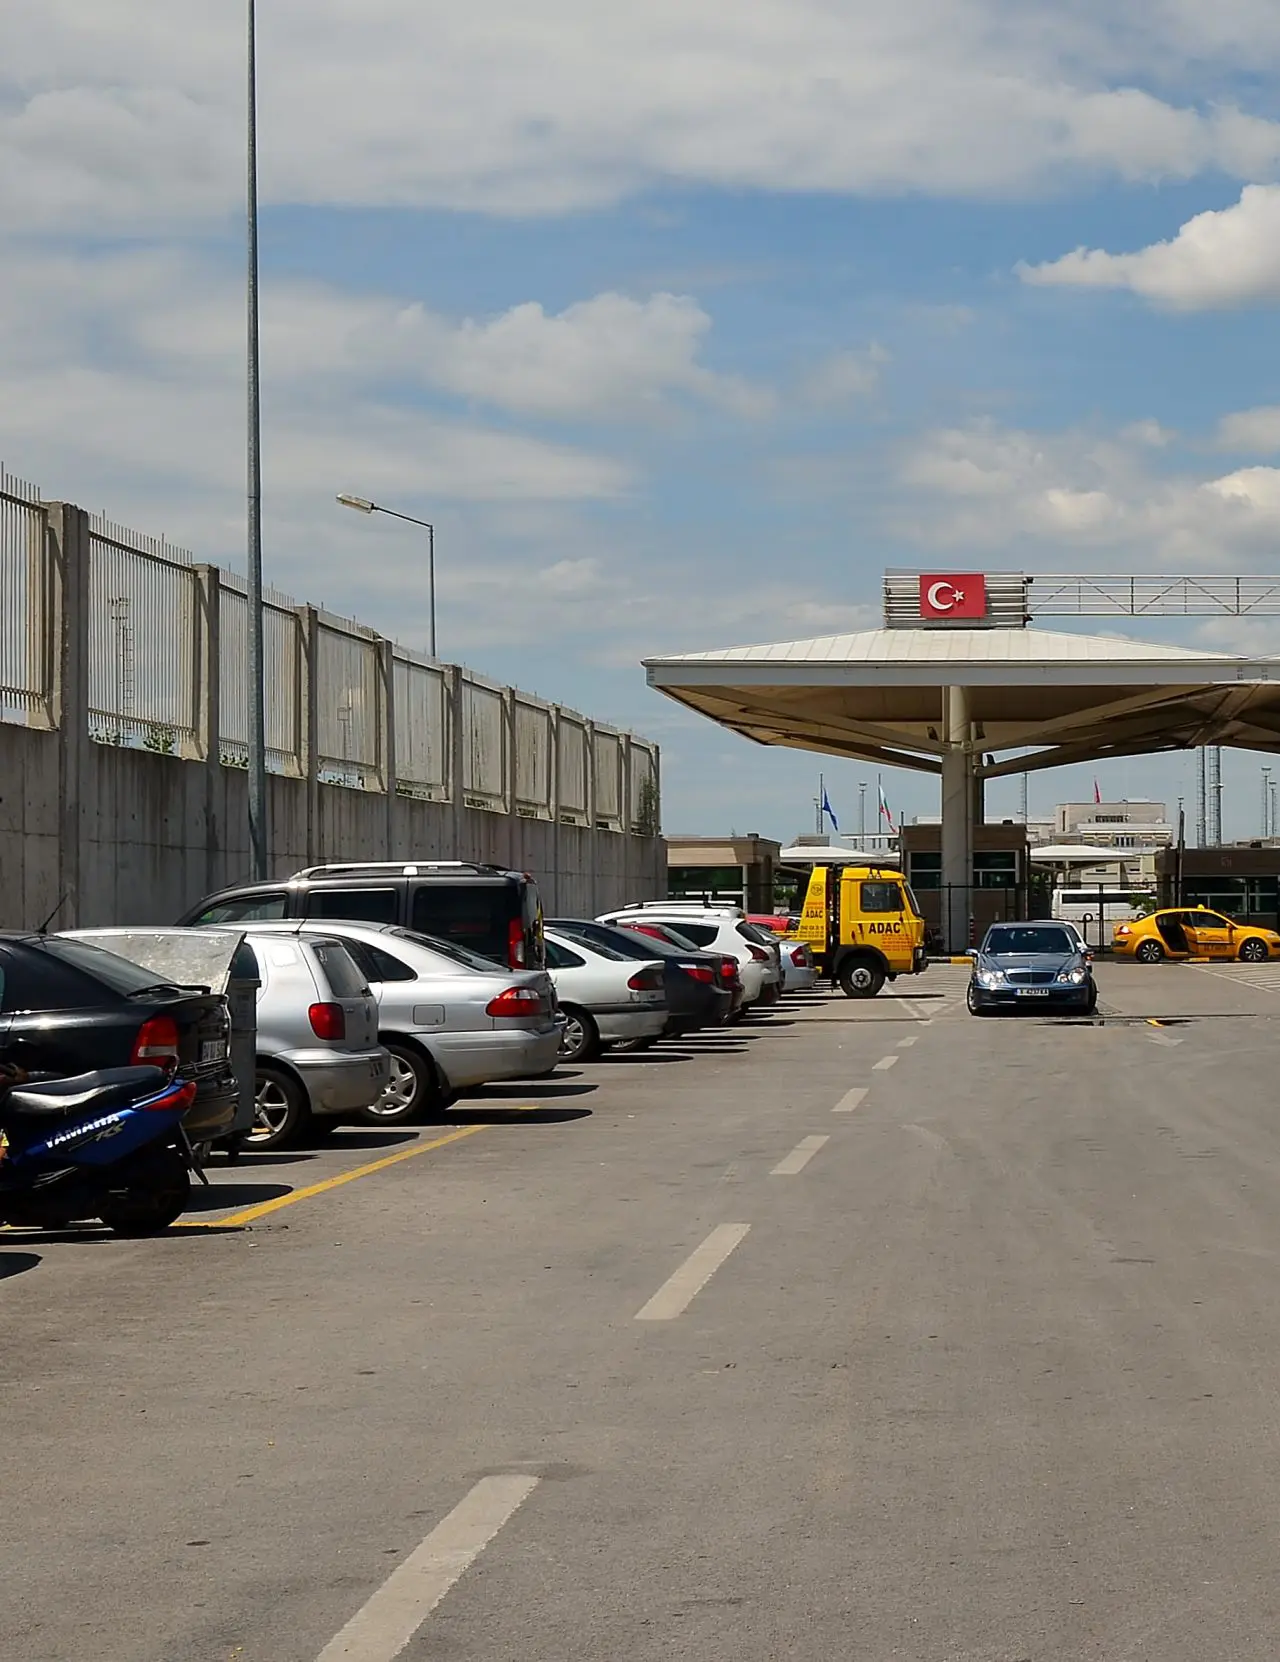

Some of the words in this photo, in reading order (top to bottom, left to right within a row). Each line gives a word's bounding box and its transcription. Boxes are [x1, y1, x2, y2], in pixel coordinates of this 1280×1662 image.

[805, 909, 824, 919] ADAC
[868, 922, 901, 934] ADAC
[44, 1112, 120, 1149] YAMAHA
